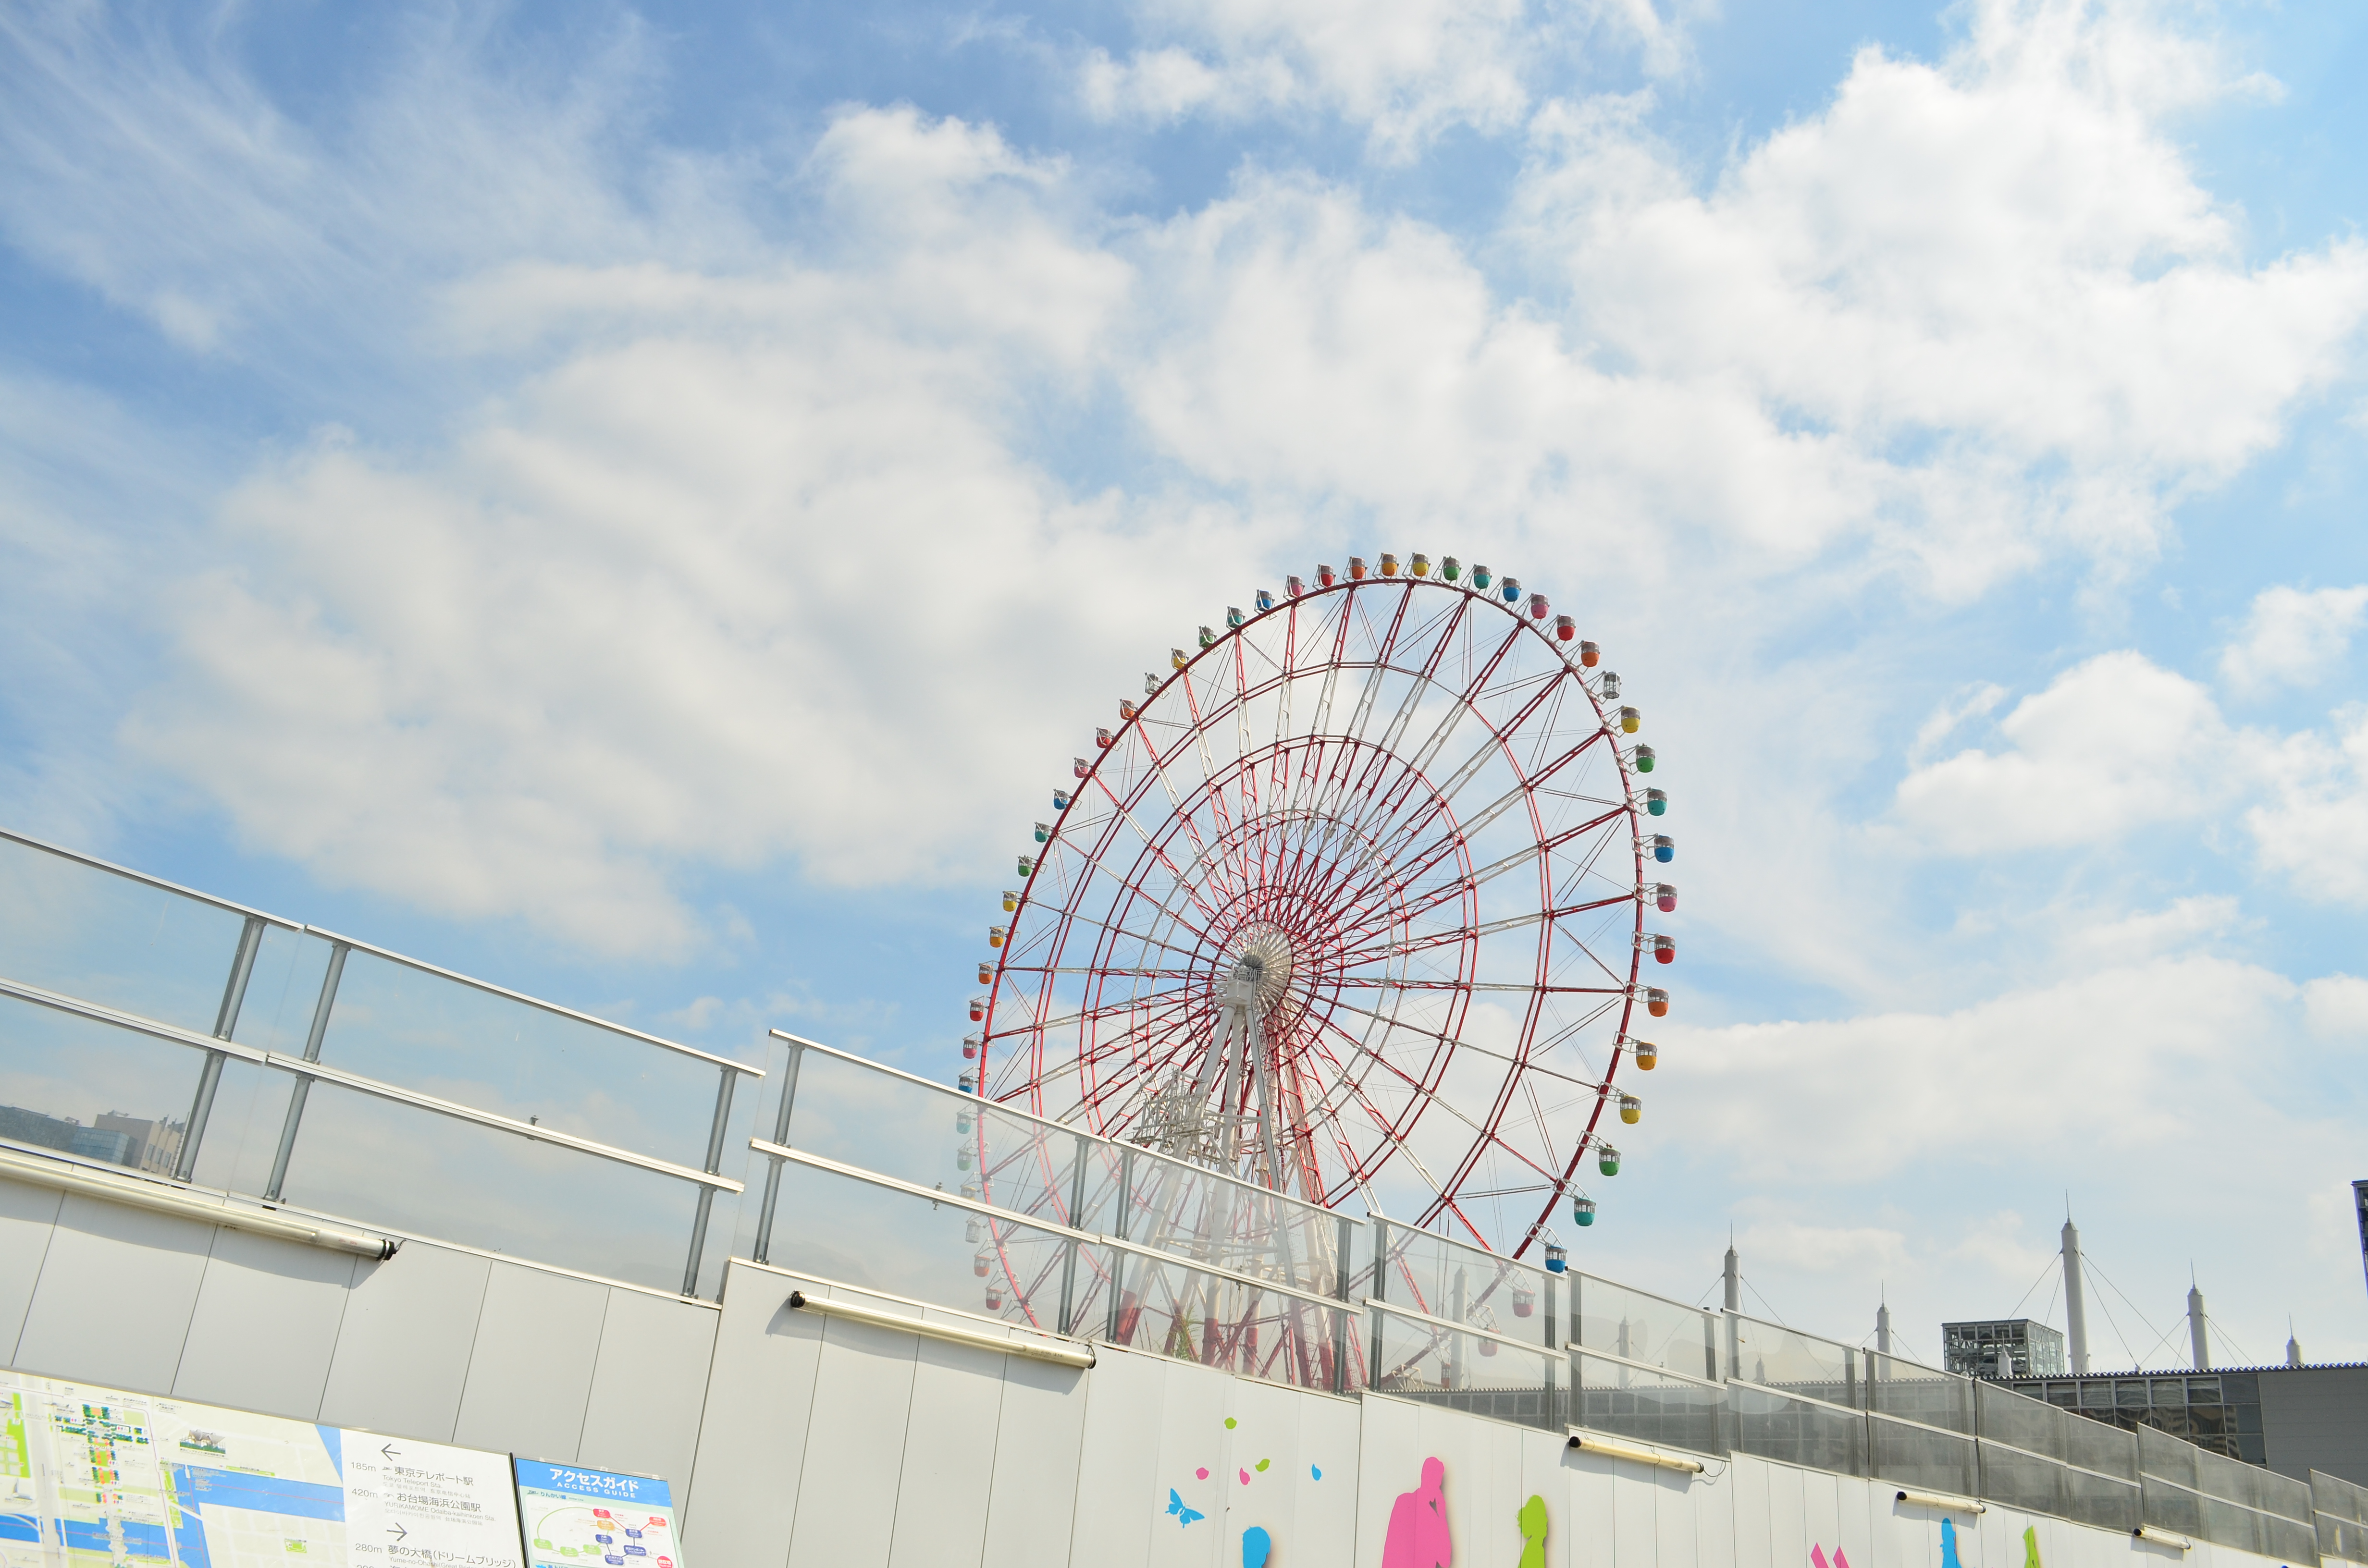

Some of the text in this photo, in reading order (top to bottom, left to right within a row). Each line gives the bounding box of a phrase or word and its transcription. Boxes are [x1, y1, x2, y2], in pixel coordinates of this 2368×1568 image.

[351, 1462, 376, 1472] 185m
[382, 1475, 401, 1483] Tokyo
[403, 1478, 429, 1487] Teleport
[394, 1466, 474, 1486] 東京テレポート駅
[550, 1468, 639, 1493] アクセスガイド
[352, 1488, 378, 1498] 420m
[541, 1491, 567, 1499] りんかい線
[557, 1482, 636, 1498] ACCESS GUIDE
[397, 1493, 481, 1512] お台場海浜公園駅
[384, 1501, 429, 1512] YURIKAMOME
[430, 1507, 483, 1519] Odaiba-kaihinkoen
[355, 1543, 382, 1554] 280m
